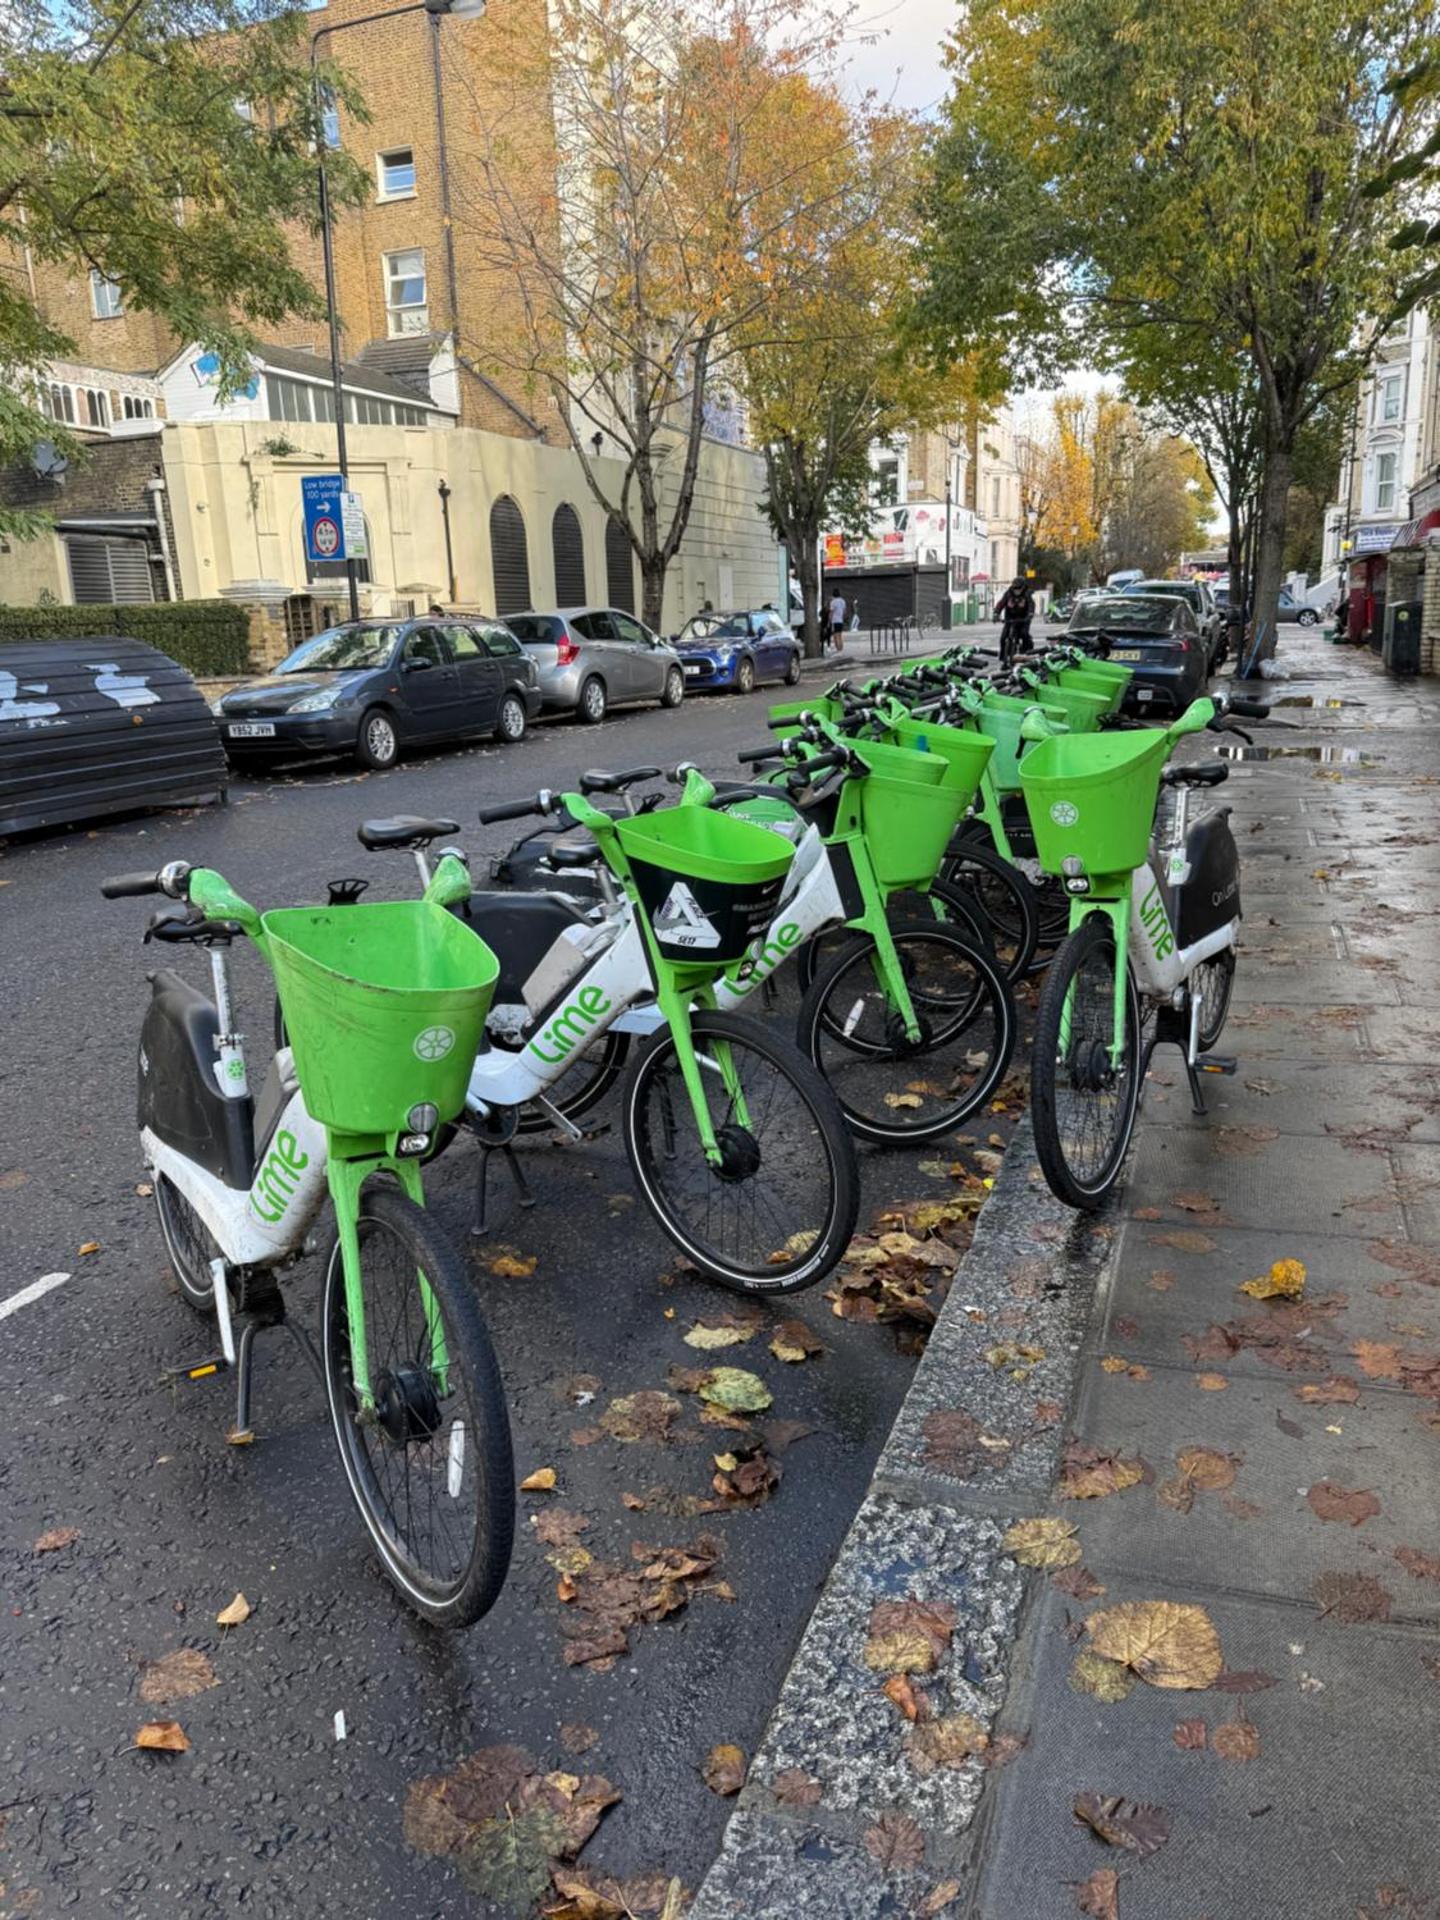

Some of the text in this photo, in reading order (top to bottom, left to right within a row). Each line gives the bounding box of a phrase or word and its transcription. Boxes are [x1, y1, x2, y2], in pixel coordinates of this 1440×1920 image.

[1140, 882, 1175, 962] Lime
[529, 986, 612, 1063] Lime
[249, 1130, 309, 1222] Lime
